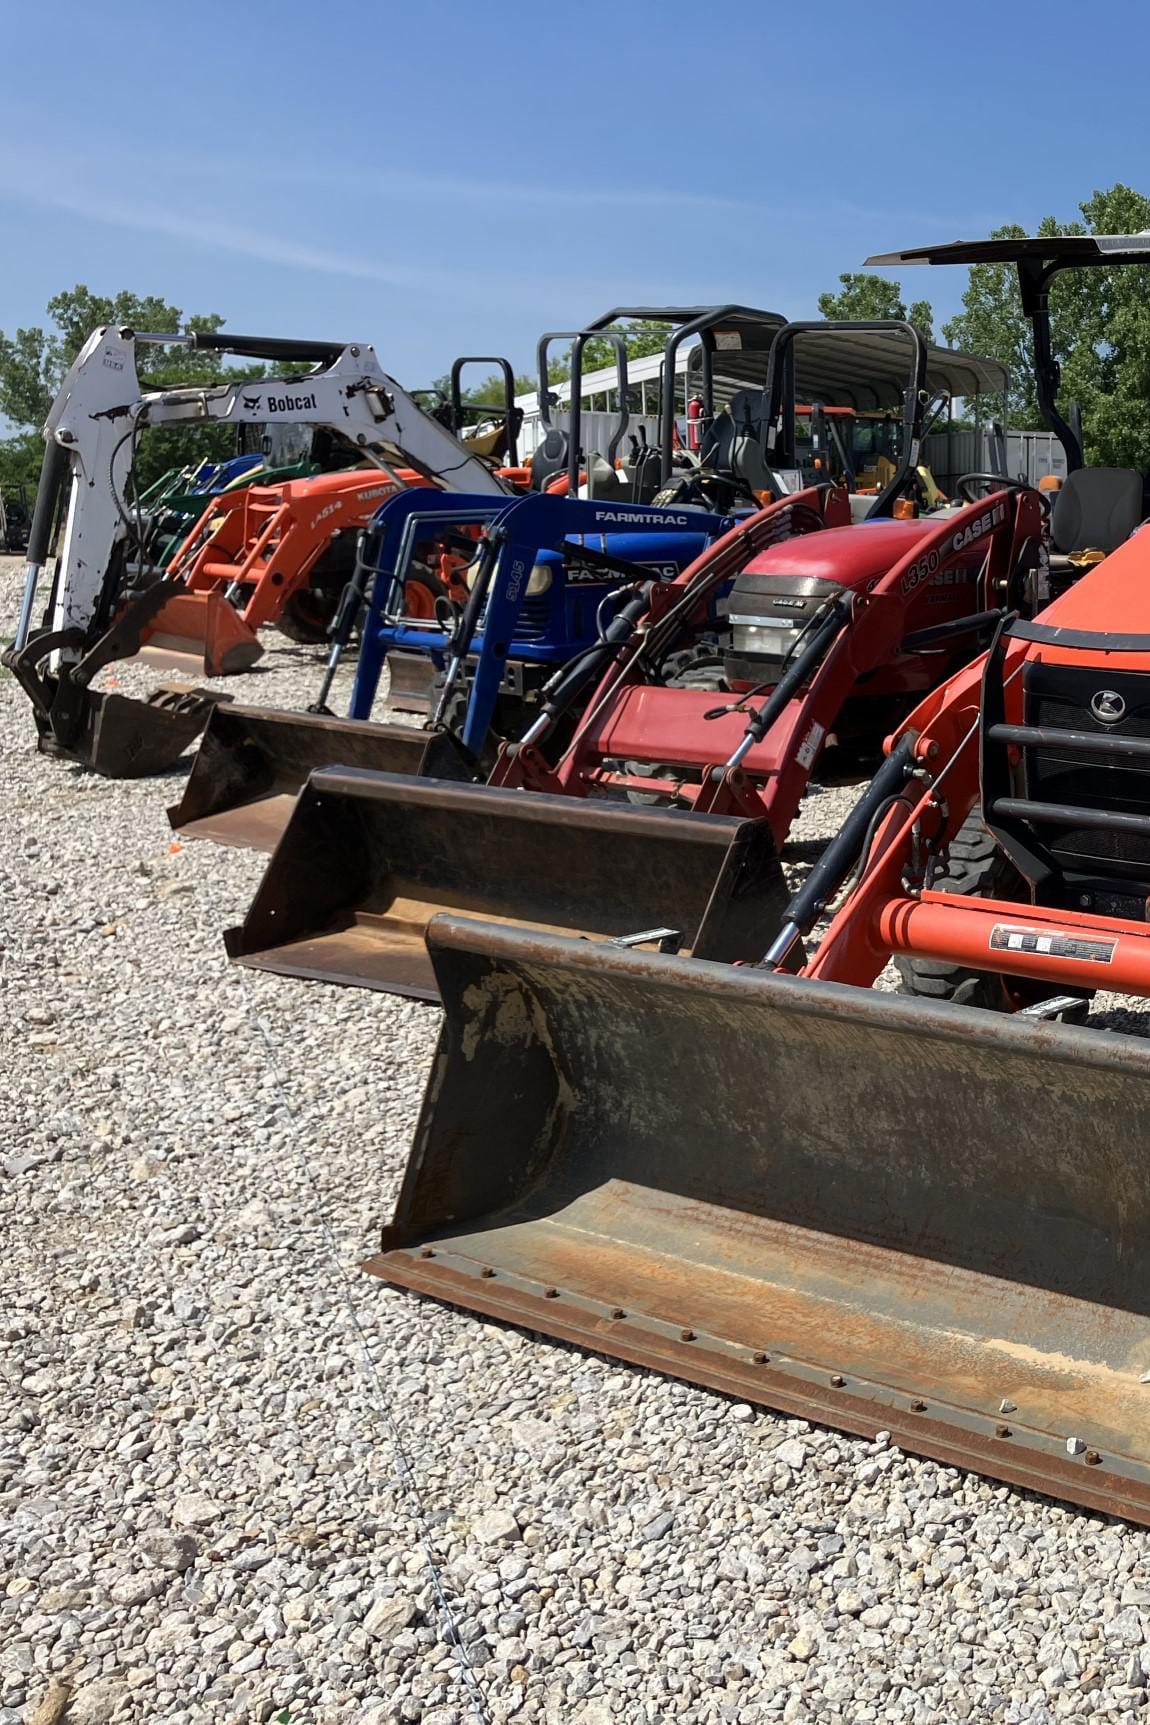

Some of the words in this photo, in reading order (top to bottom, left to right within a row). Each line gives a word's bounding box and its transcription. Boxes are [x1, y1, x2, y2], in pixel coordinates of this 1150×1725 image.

[267, 393, 317, 413] Bobcat
[357, 484, 398, 501] KUBOTA
[595, 511, 688, 526] FARMTRAC
[900, 549, 940, 596] L350
[952, 512, 992, 551] CASE
